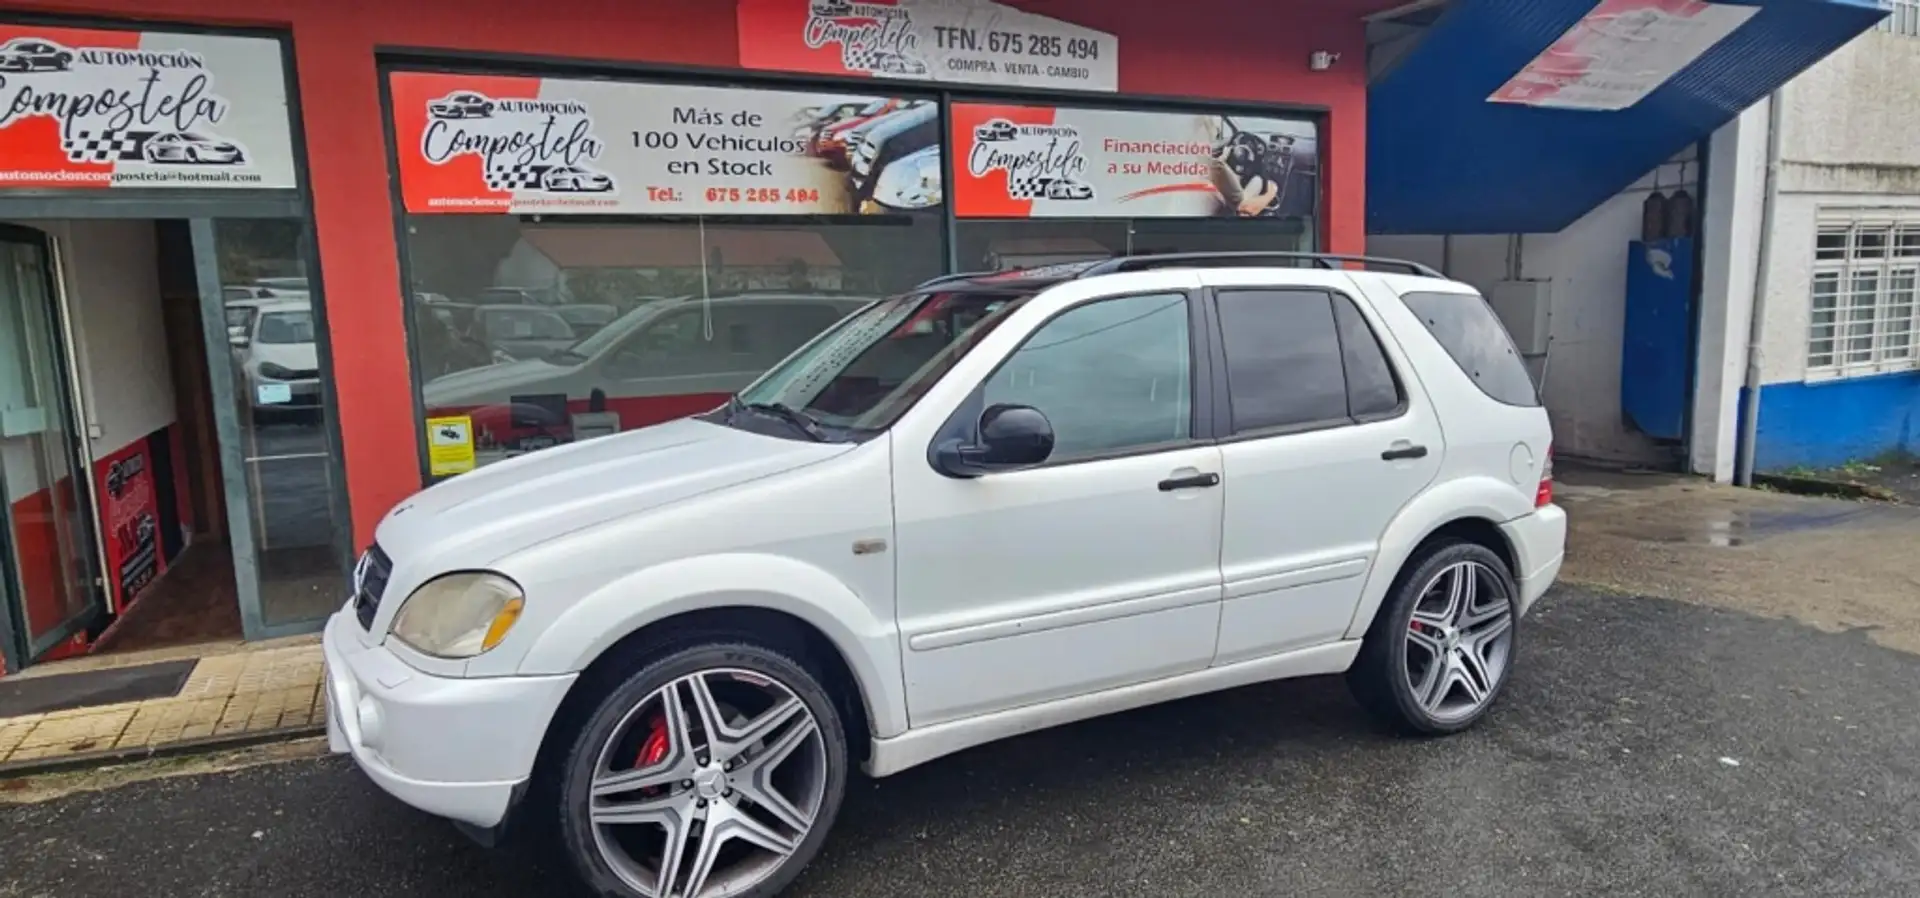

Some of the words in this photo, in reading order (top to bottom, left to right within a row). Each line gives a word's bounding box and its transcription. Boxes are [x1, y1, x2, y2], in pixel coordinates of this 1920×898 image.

[933, 25, 983, 52] TFN.
[988, 31, 1023, 54] 675
[1028, 34, 1061, 58] 285
[1067, 37, 1098, 60] 494
[78, 50, 203, 70] AUTOMOCIÓN
[947, 58, 997, 73] COMPRA
[1004, 62, 1039, 77] VENTA
[1046, 65, 1089, 80] CAMBIO
[497, 101, 586, 115] AUTOMOCIÓN
[672, 107, 723, 126] Más
[731, 110, 763, 127] de
[424, 116, 602, 172] Compostela
[632, 131, 678, 149] 100
[1103, 137, 1212, 156] Financiación
[667, 160, 700, 174] en
[707, 157, 773, 176] Stock
[970, 137, 1087, 182] Compostela
[1107, 162, 1118, 174] a
[1122, 162, 1143, 175] su
[1147, 161, 1208, 176] Medida
[647, 186, 683, 202] Tel.:
[705, 187, 740, 202] 675
[746, 188, 780, 203] 285
[785, 188, 820, 204] 494
